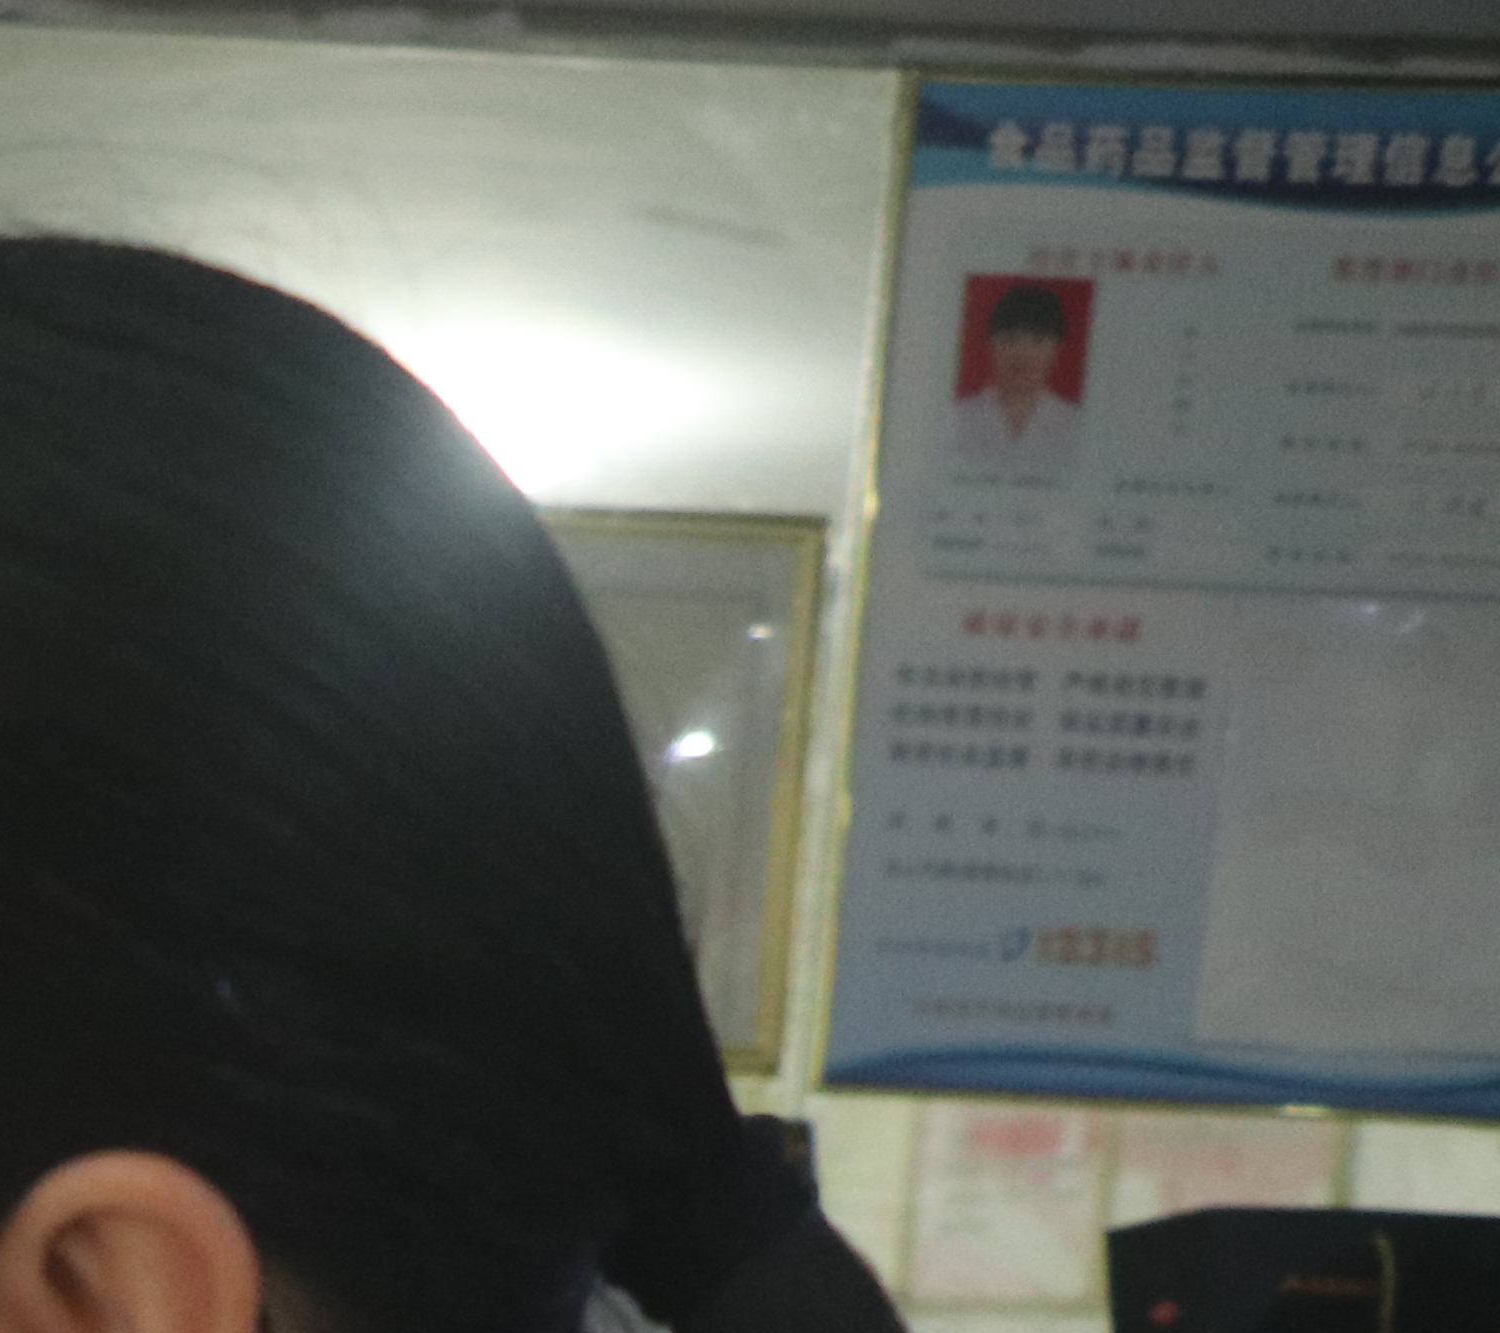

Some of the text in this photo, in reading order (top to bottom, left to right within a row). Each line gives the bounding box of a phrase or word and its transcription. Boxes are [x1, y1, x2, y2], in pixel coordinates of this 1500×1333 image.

[988, 119, 1500, 189] 食品药品监督管理信息
